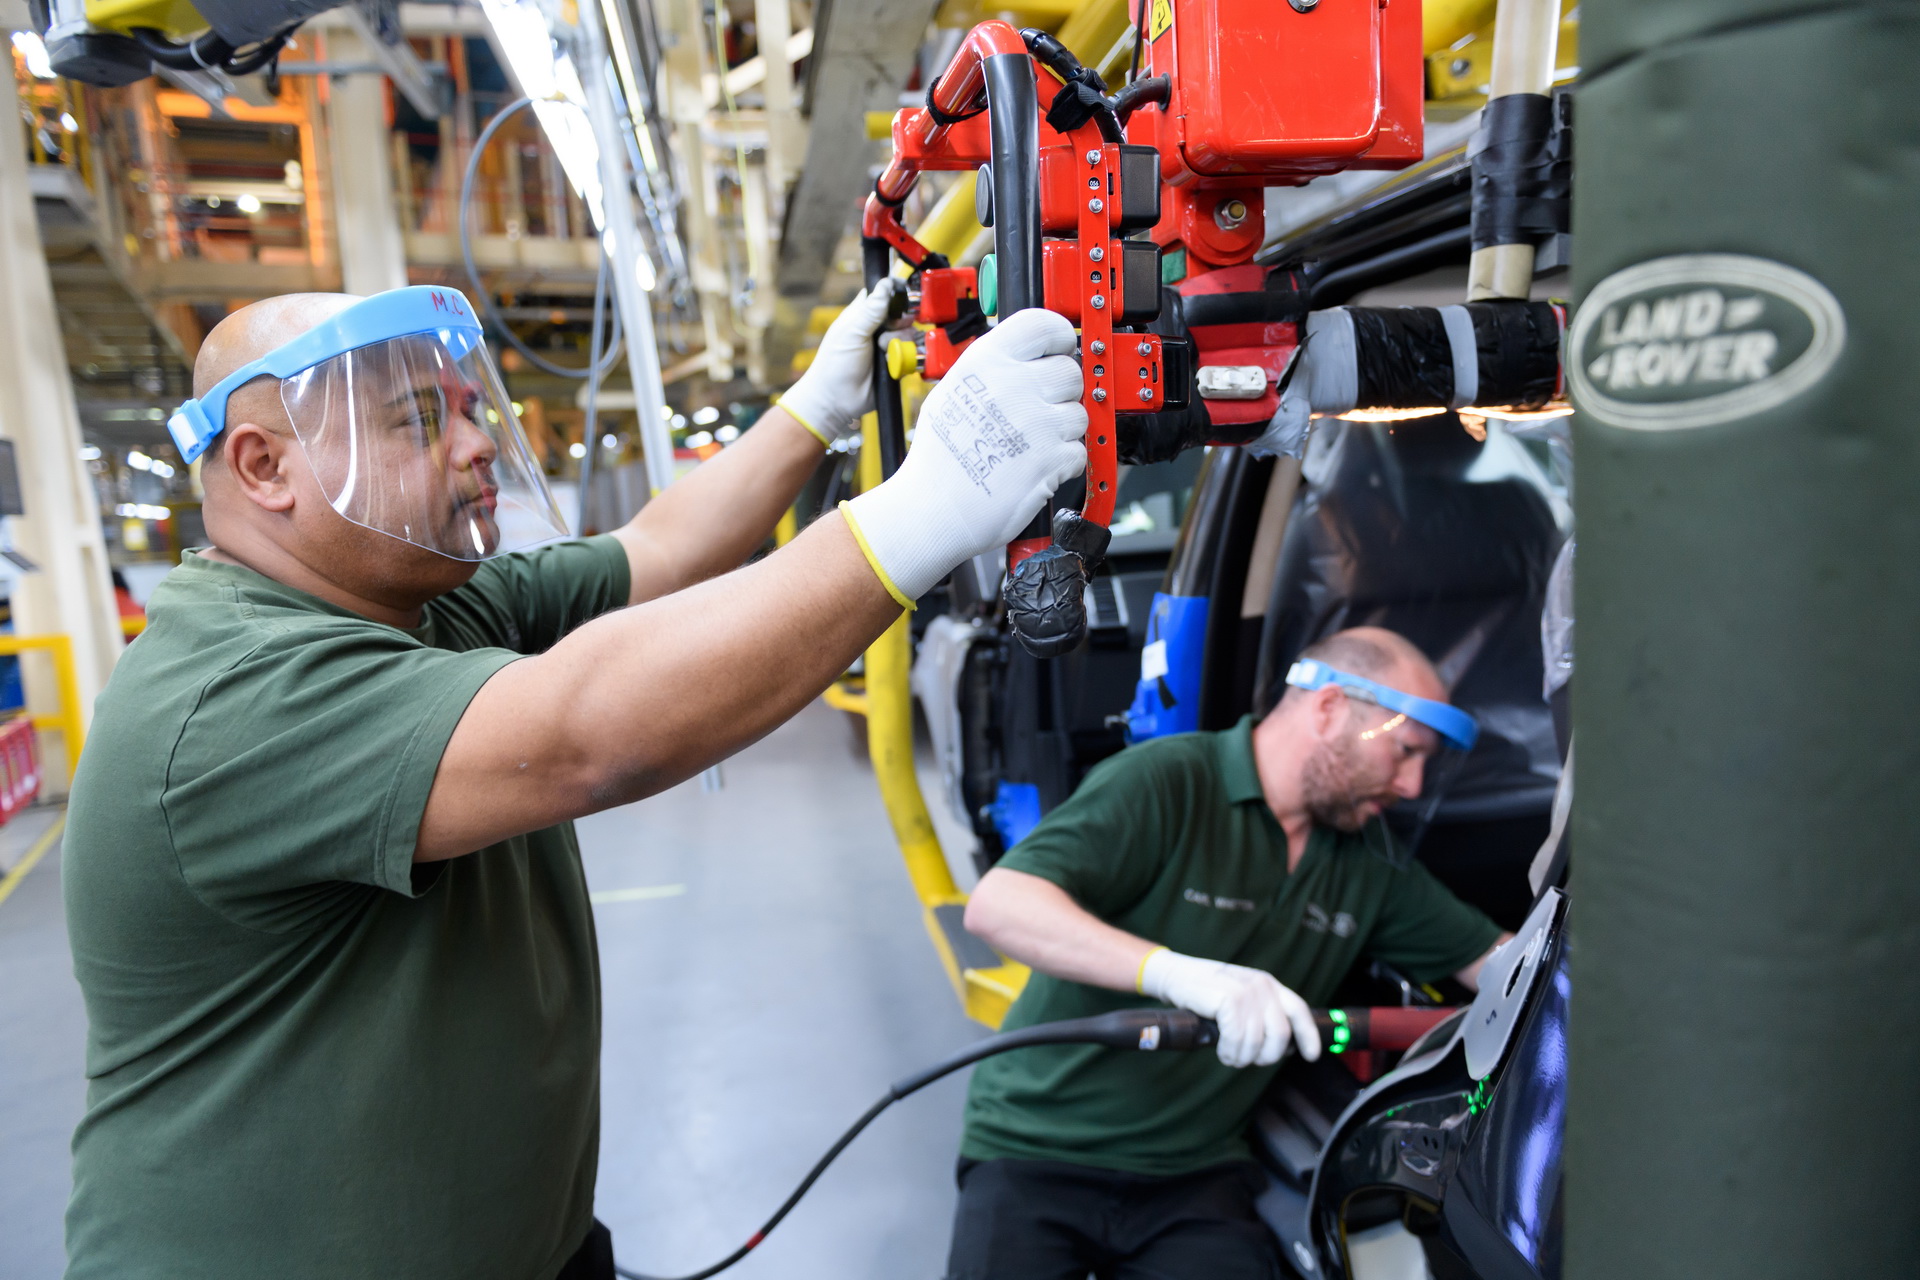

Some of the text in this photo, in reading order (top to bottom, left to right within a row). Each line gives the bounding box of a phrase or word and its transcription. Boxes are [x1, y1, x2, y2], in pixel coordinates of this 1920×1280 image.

[1599, 288, 1725, 346] LAND
[1607, 330, 1779, 389] ROVER
[979, 391, 1032, 451] Liscombe
